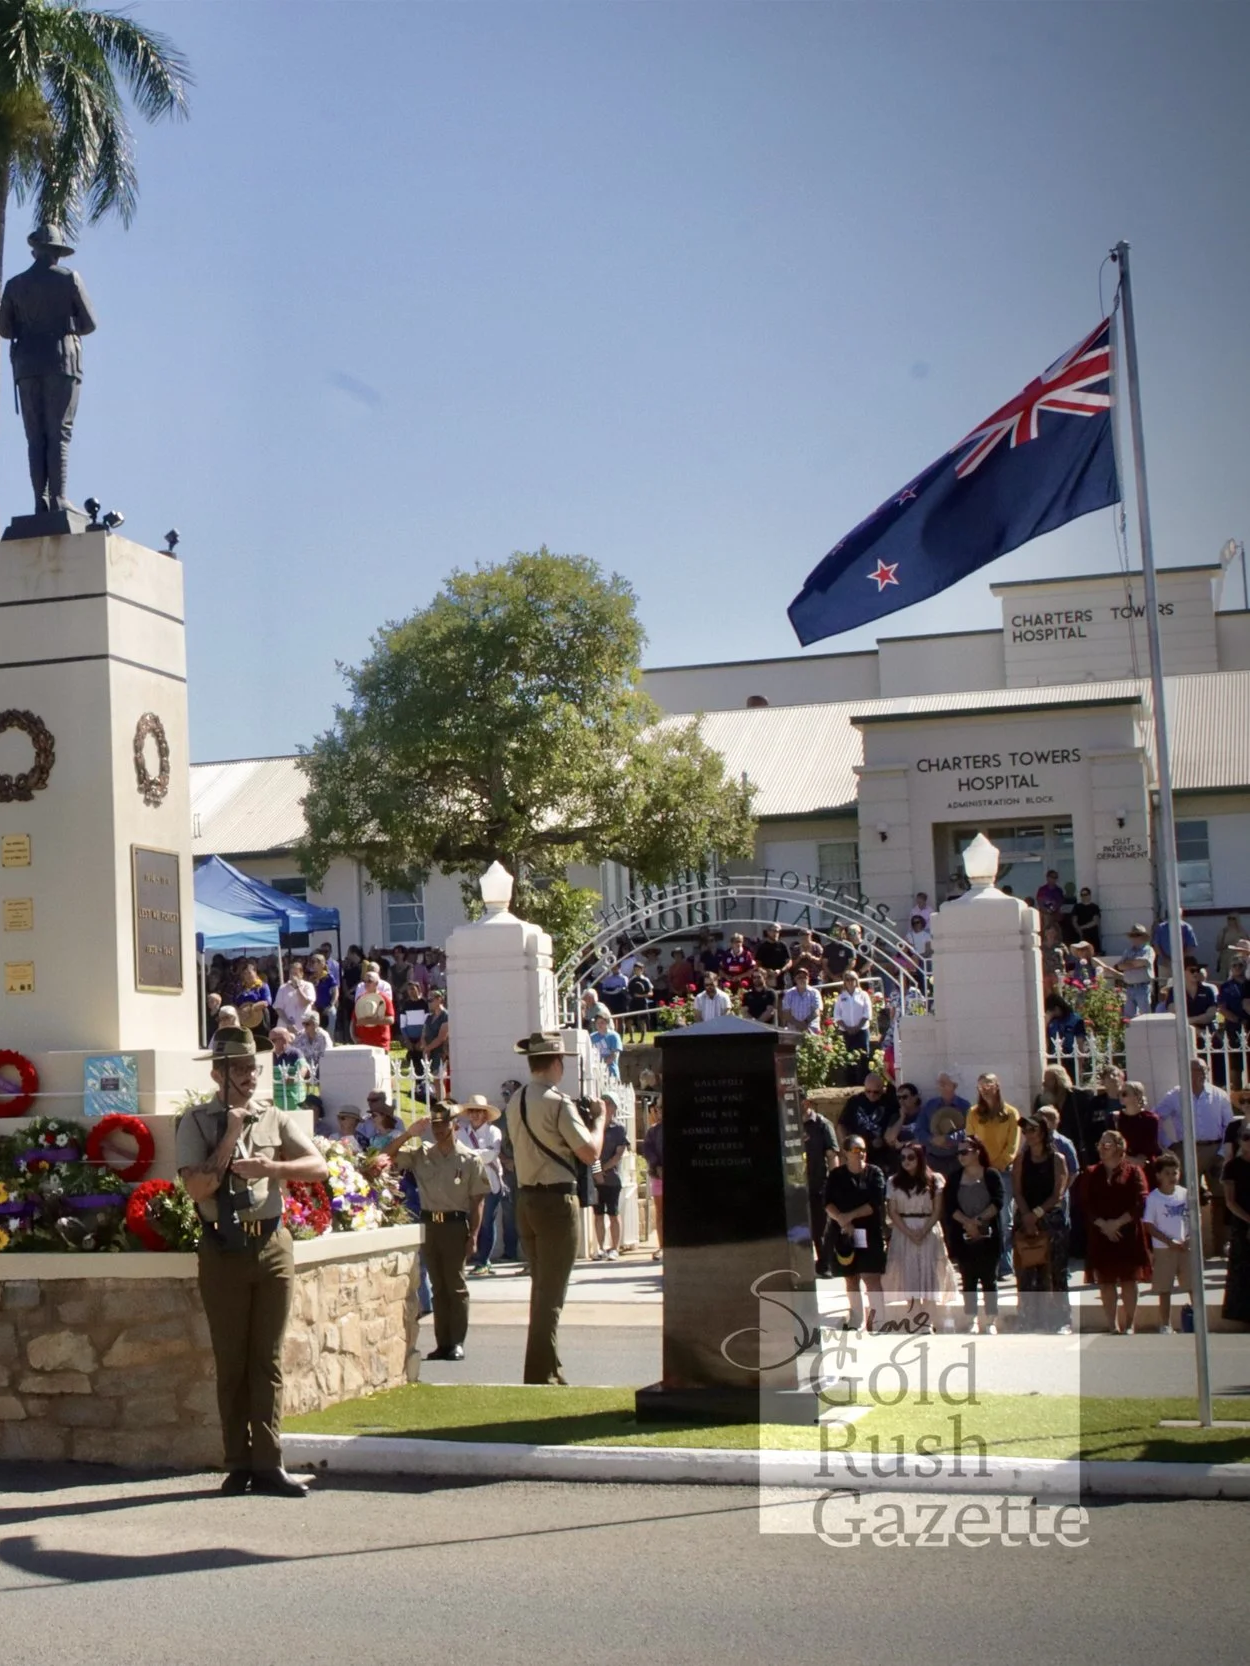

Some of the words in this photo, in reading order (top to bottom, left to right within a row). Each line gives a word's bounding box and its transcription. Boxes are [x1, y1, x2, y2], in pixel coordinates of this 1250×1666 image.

[1011, 609, 1093, 628] CHARTERS
[1110, 602, 1174, 620] TOWRS
[1012, 625, 1087, 643] HOSPITAL
[916, 753, 1001, 773] CHARTERS
[1008, 748, 1081, 767] TOWERS
[957, 773, 1039, 792] HOSPITAL
[947, 797, 1021, 809] ADMINISTRATION
[1025, 795, 1054, 804] BLOCK
[1112, 837, 1131, 845] OUT
[1096, 850, 1148, 860] DEPARTMENT
[760, 867, 890, 924] TOWERS
